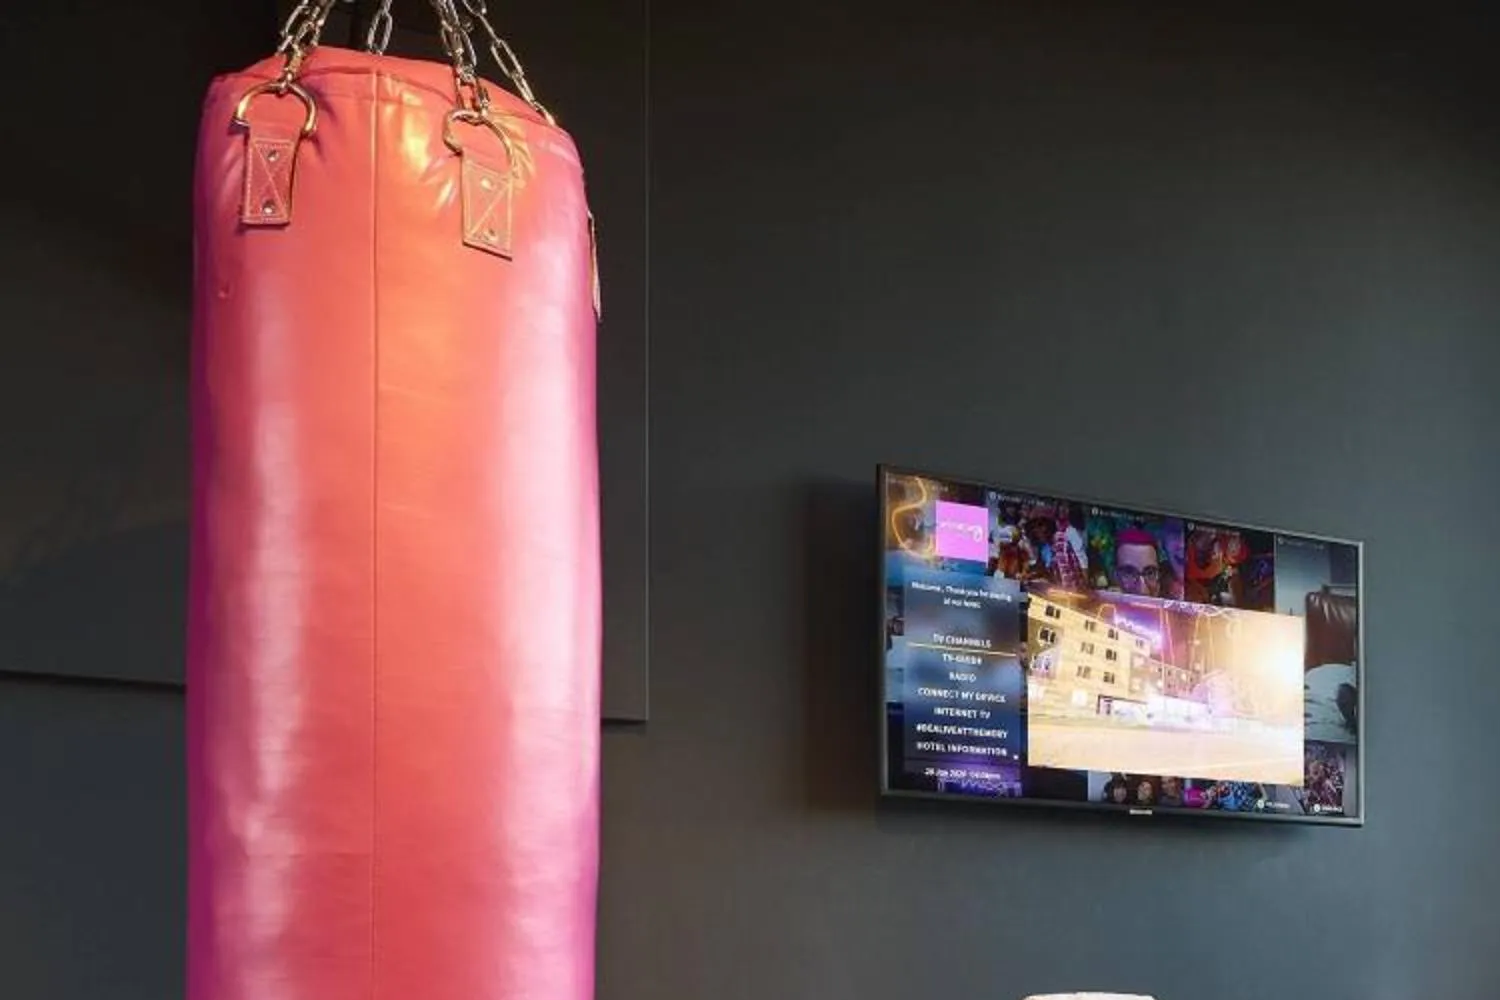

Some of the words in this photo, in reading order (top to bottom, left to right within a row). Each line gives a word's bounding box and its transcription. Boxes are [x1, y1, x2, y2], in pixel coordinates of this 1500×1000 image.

[918, 687, 959, 699] CONNECT
[961, 691, 975, 701] MY
[976, 692, 1007, 703] DEVICE
[933, 706, 978, 719] INTERNET
[980, 709, 991, 719] TV
[916, 741, 946, 753] HOTEL
[947, 743, 1007, 757] INFORMATION
